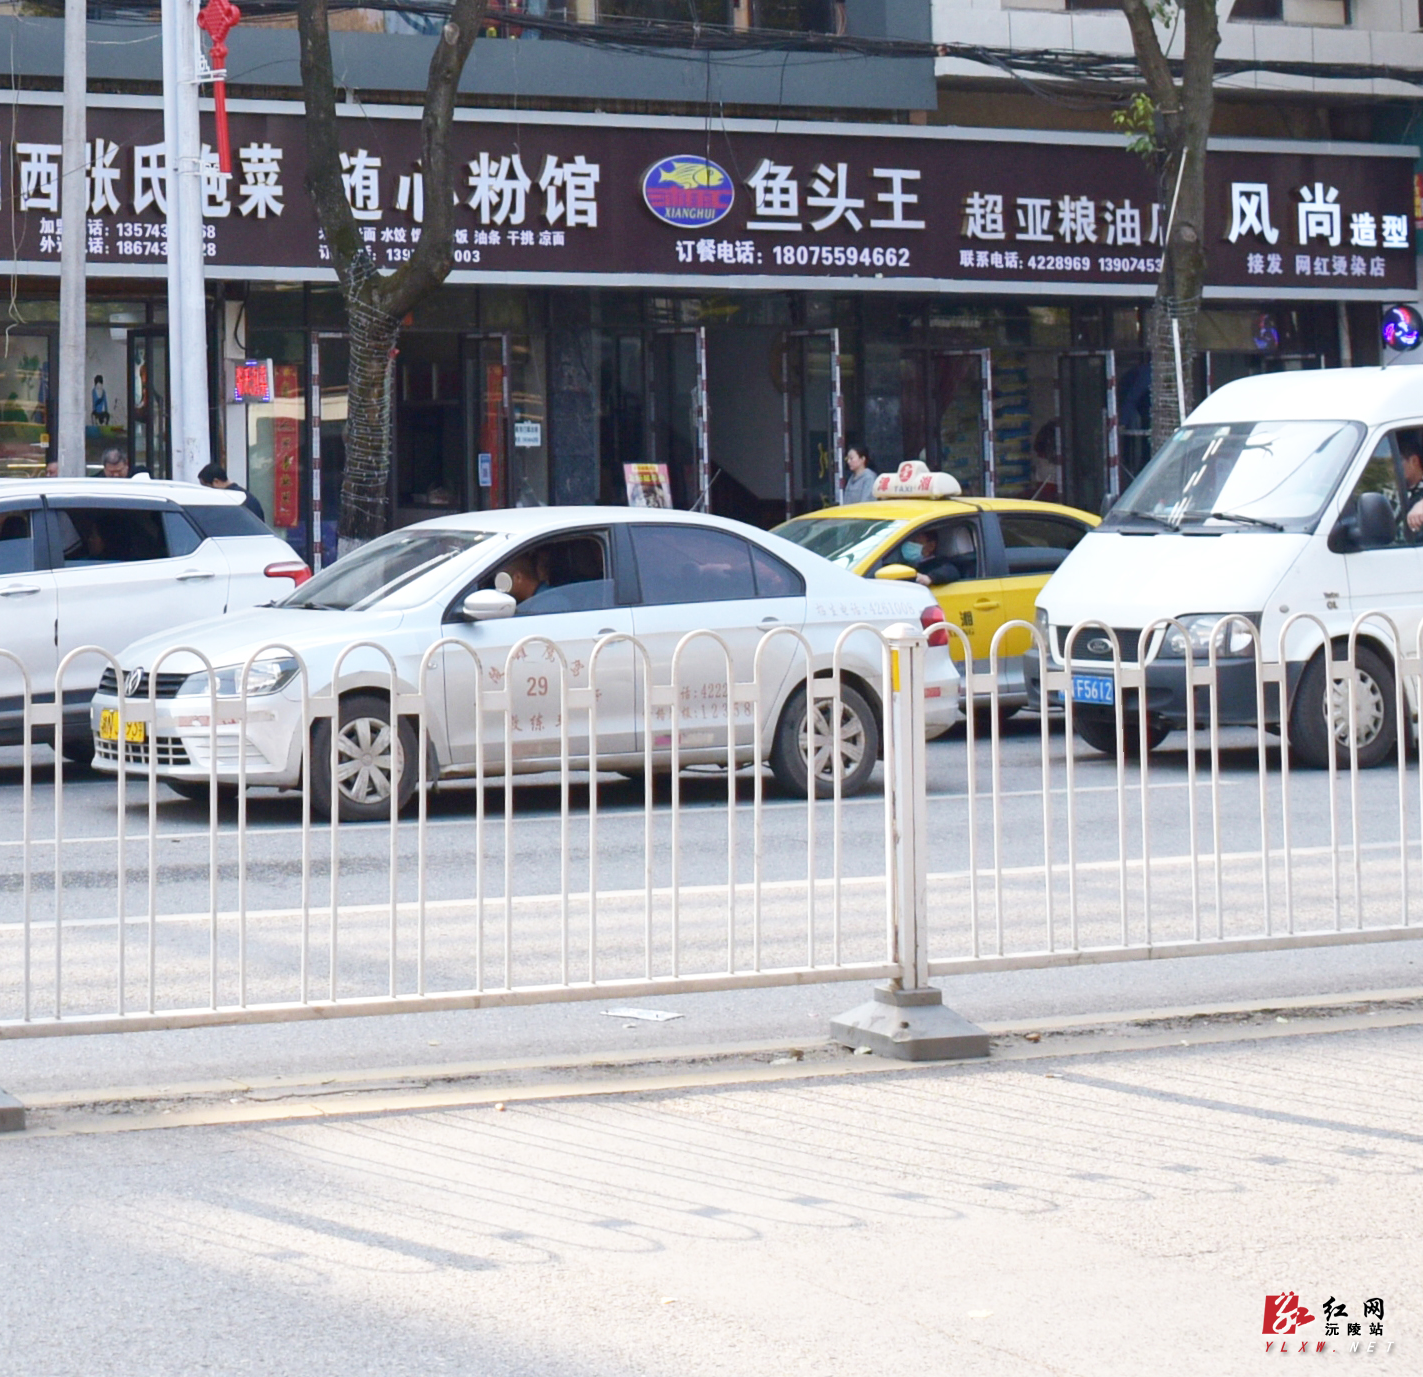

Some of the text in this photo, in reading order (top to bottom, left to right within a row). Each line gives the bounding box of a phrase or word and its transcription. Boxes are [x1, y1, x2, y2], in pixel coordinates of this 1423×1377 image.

[747, 158, 926, 232] 鱼头王
[664, 207, 716, 220] XIANGHUI
[381, 227, 407, 243] 水饺
[474, 230, 501, 245] 油条
[539, 230, 565, 246] 凉面
[1247, 253, 1385, 277] 接发 网红烫染店
[894, 485, 914, 493] TAXI
[527, 676, 549, 697] 29
